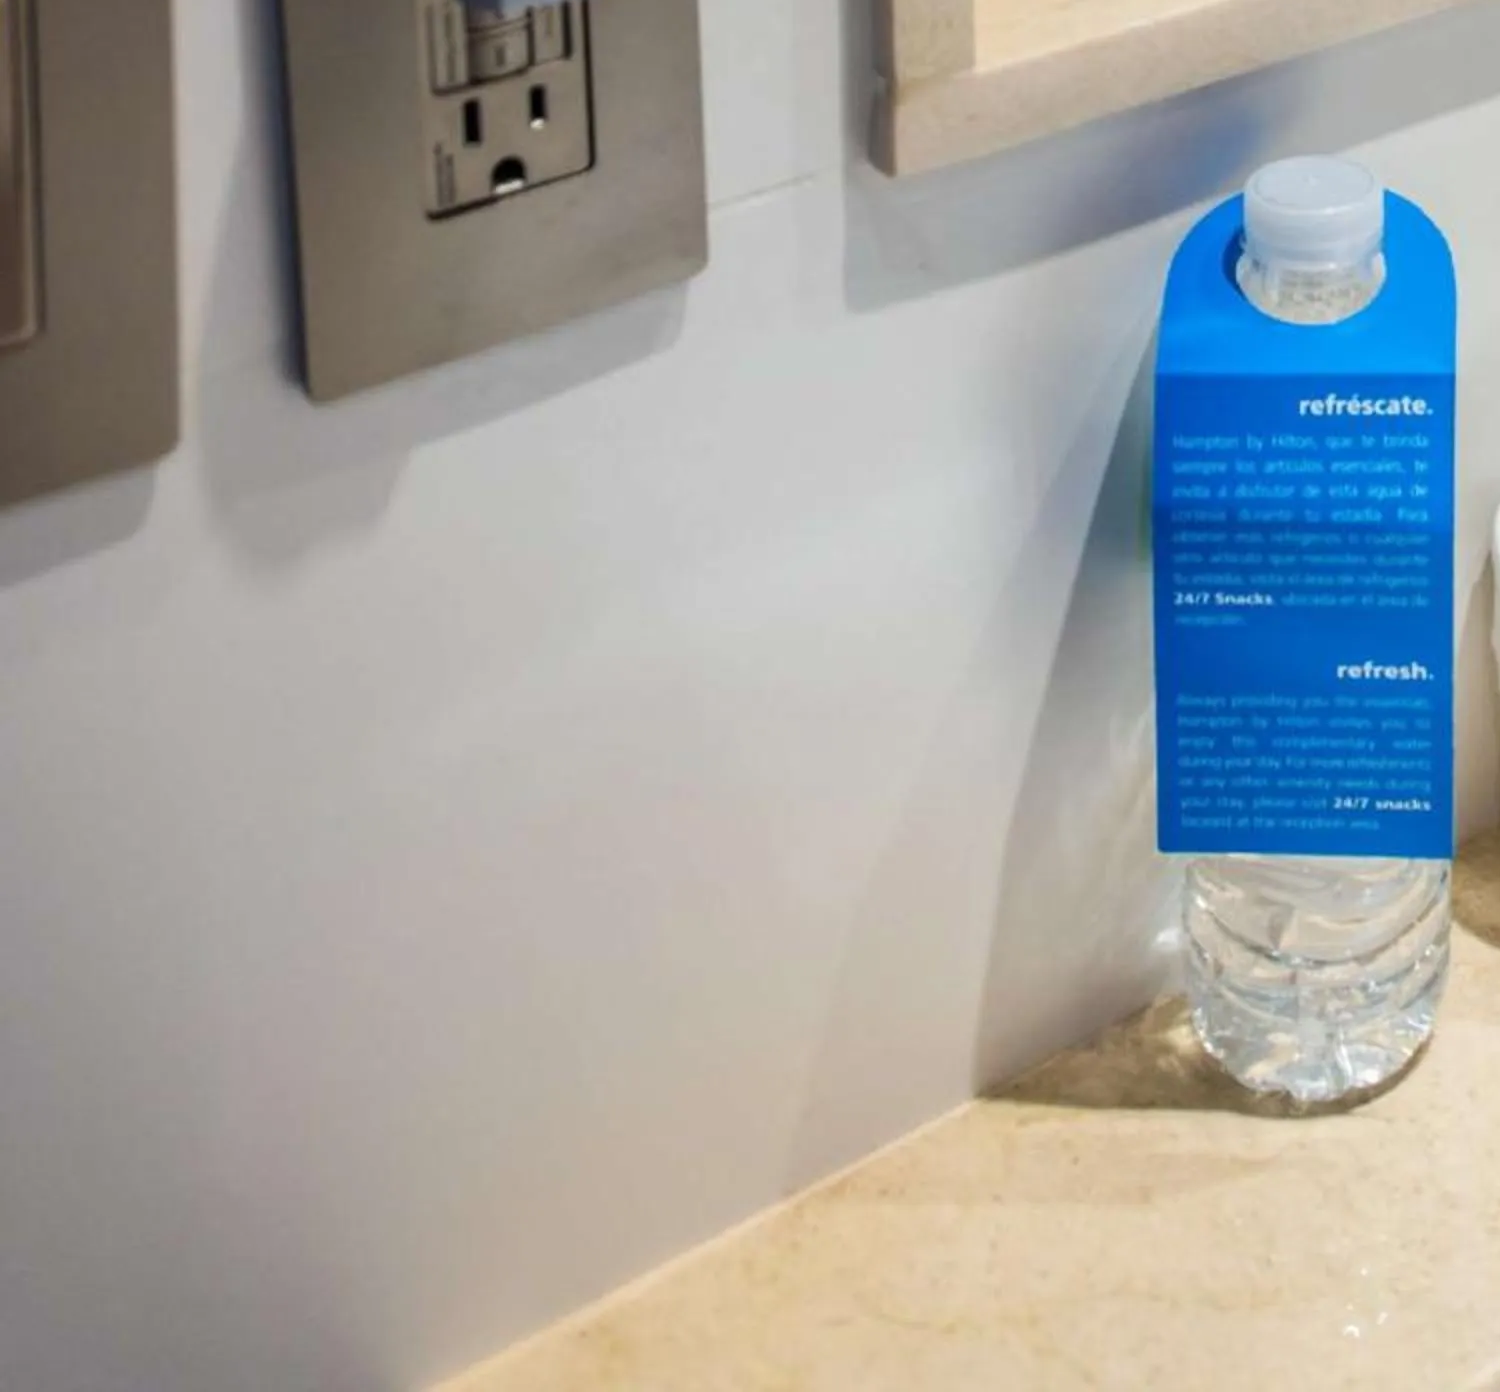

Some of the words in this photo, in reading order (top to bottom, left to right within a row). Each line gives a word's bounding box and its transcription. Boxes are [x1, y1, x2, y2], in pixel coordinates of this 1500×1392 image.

[1299, 393, 1434, 417] refréscate.
[1173, 592, 1210, 606] 24/7
[1336, 659, 1434, 681] refresh.
[1333, 797, 1369, 810] 24/7
[1375, 798, 1432, 811] snacks
